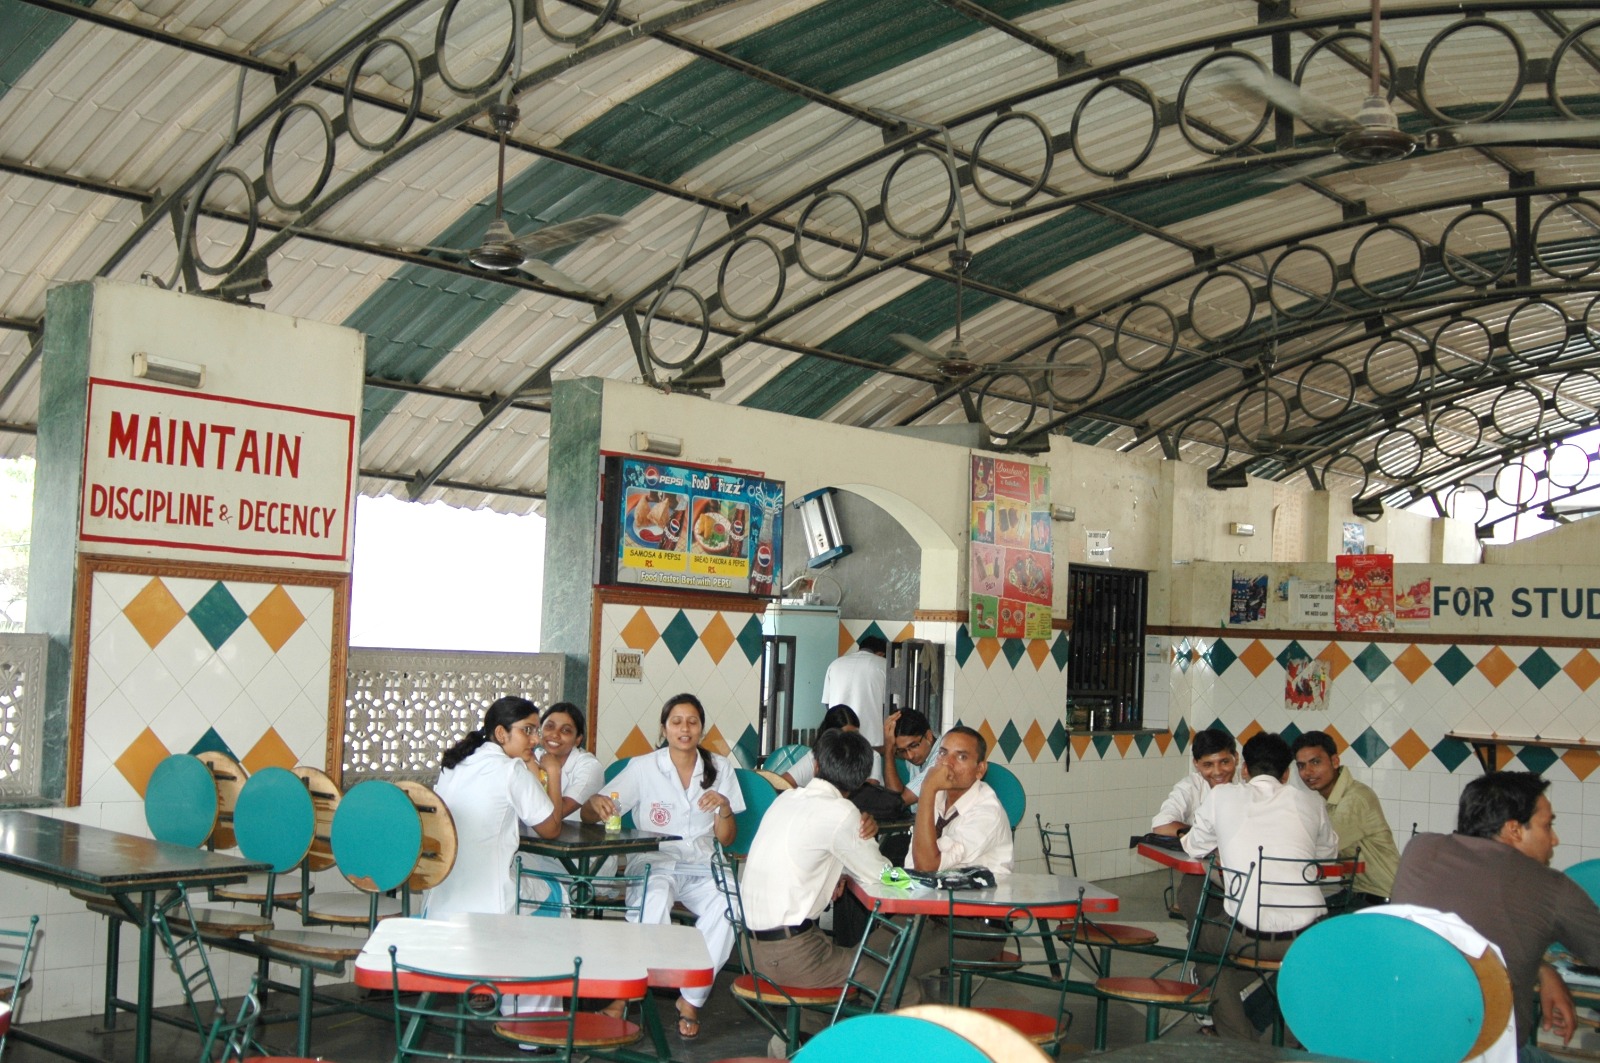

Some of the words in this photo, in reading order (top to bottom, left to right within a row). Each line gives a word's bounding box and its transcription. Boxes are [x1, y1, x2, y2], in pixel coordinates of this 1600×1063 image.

[108, 411, 302, 479] MAINTAIN
[659, 475, 684, 486] PEPSI
[90, 483, 215, 528] DISCIPLINE
[219, 504, 233, 525] &
[238, 499, 337, 539] DECENCY
[630, 549, 656, 559] SAMOSA
[664, 552, 682, 561] PEPSI
[694, 555, 707, 564] BREAD
[732, 560, 746, 568] PEPSI
[641, 571, 658, 583] Food
[659, 572, 680, 585] Tastes
[681, 575, 696, 586] Best
[696, 576, 711, 587] with
[712, 577, 732, 589] PEPSI
[1433, 586, 1495, 618] FOR
[1511, 587, 1600, 620] STUD
